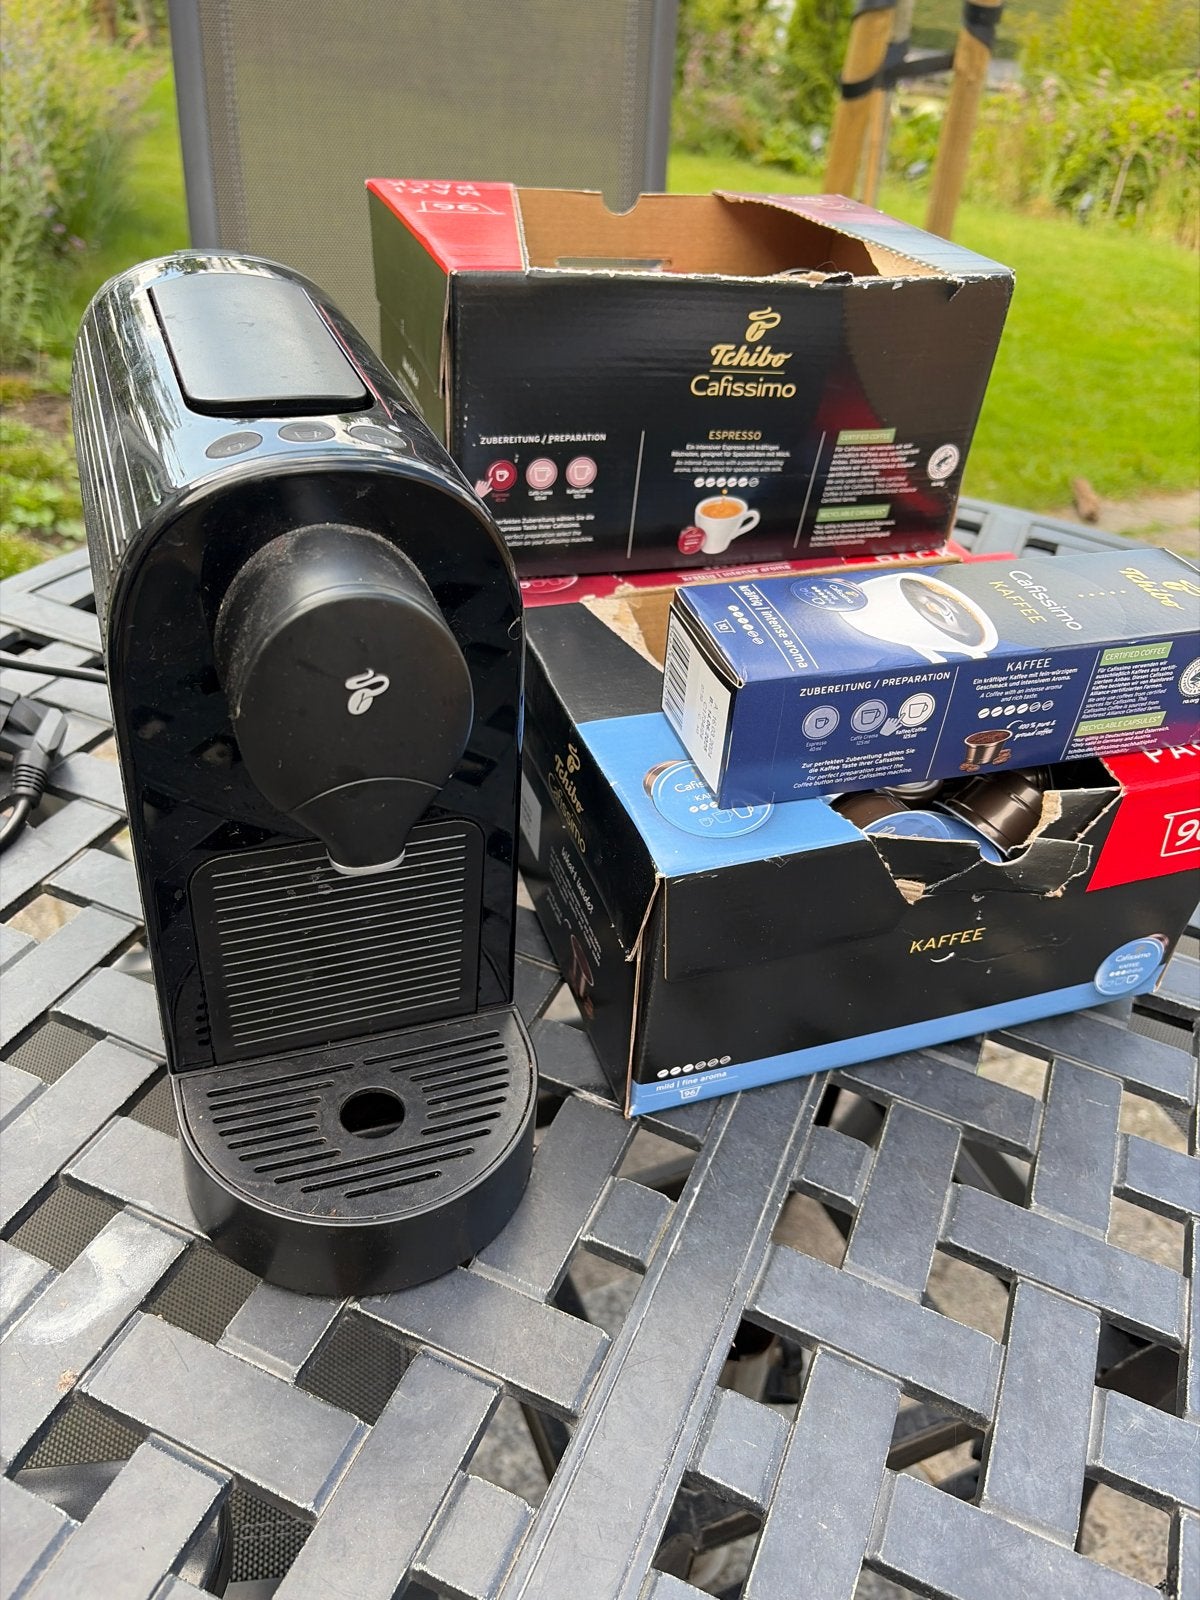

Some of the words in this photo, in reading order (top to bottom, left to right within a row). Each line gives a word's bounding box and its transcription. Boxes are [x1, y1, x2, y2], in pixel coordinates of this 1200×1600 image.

[711, 343, 793, 368] Tchibo
[690, 374, 797, 398] Cafissimo
[480, 435, 541, 445] ZUBEREITUNG
[548, 434, 607, 444] PREPARATION
[708, 430, 762, 440] ESPRESSO
[1118, 567, 1185, 611] Tchibo
[989, 581, 1048, 624] KAFFEE
[1009, 570, 1083, 631] Cafissimo
[718, 623, 729, 631] 10
[738, 585, 763, 607] kräftig
[761, 610, 789, 639] intense
[783, 639, 808, 669] aroma
[1105, 651, 1139, 661] CERTIFIED
[1140, 647, 1167, 657] COFFEE
[1006, 657, 1052, 672] KAFFEE
[800, 681, 871, 696] ZUBEREITUNG
[882, 672, 950, 686] PREPARATION
[976, 682, 1008, 690] Geschmack
[1080, 722, 1121, 732] RECYCLABLE
[814, 759, 844, 767] perfekten
[845, 754, 882, 762] Zubereitung
[875, 756, 905, 764] Cafissimo.
[840, 768, 874, 777] preparation
[555, 754, 584, 813] Tchibo
[674, 781, 705, 793] Cafis
[548, 772, 586, 853] Cafissimo
[1175, 819, 1200, 846] 9
[910, 927, 987, 953] KAFFEE
[1116, 953, 1151, 962] Cafissimo
[656, 1082, 675, 1091] mild
[700, 1071, 727, 1081] aroma
